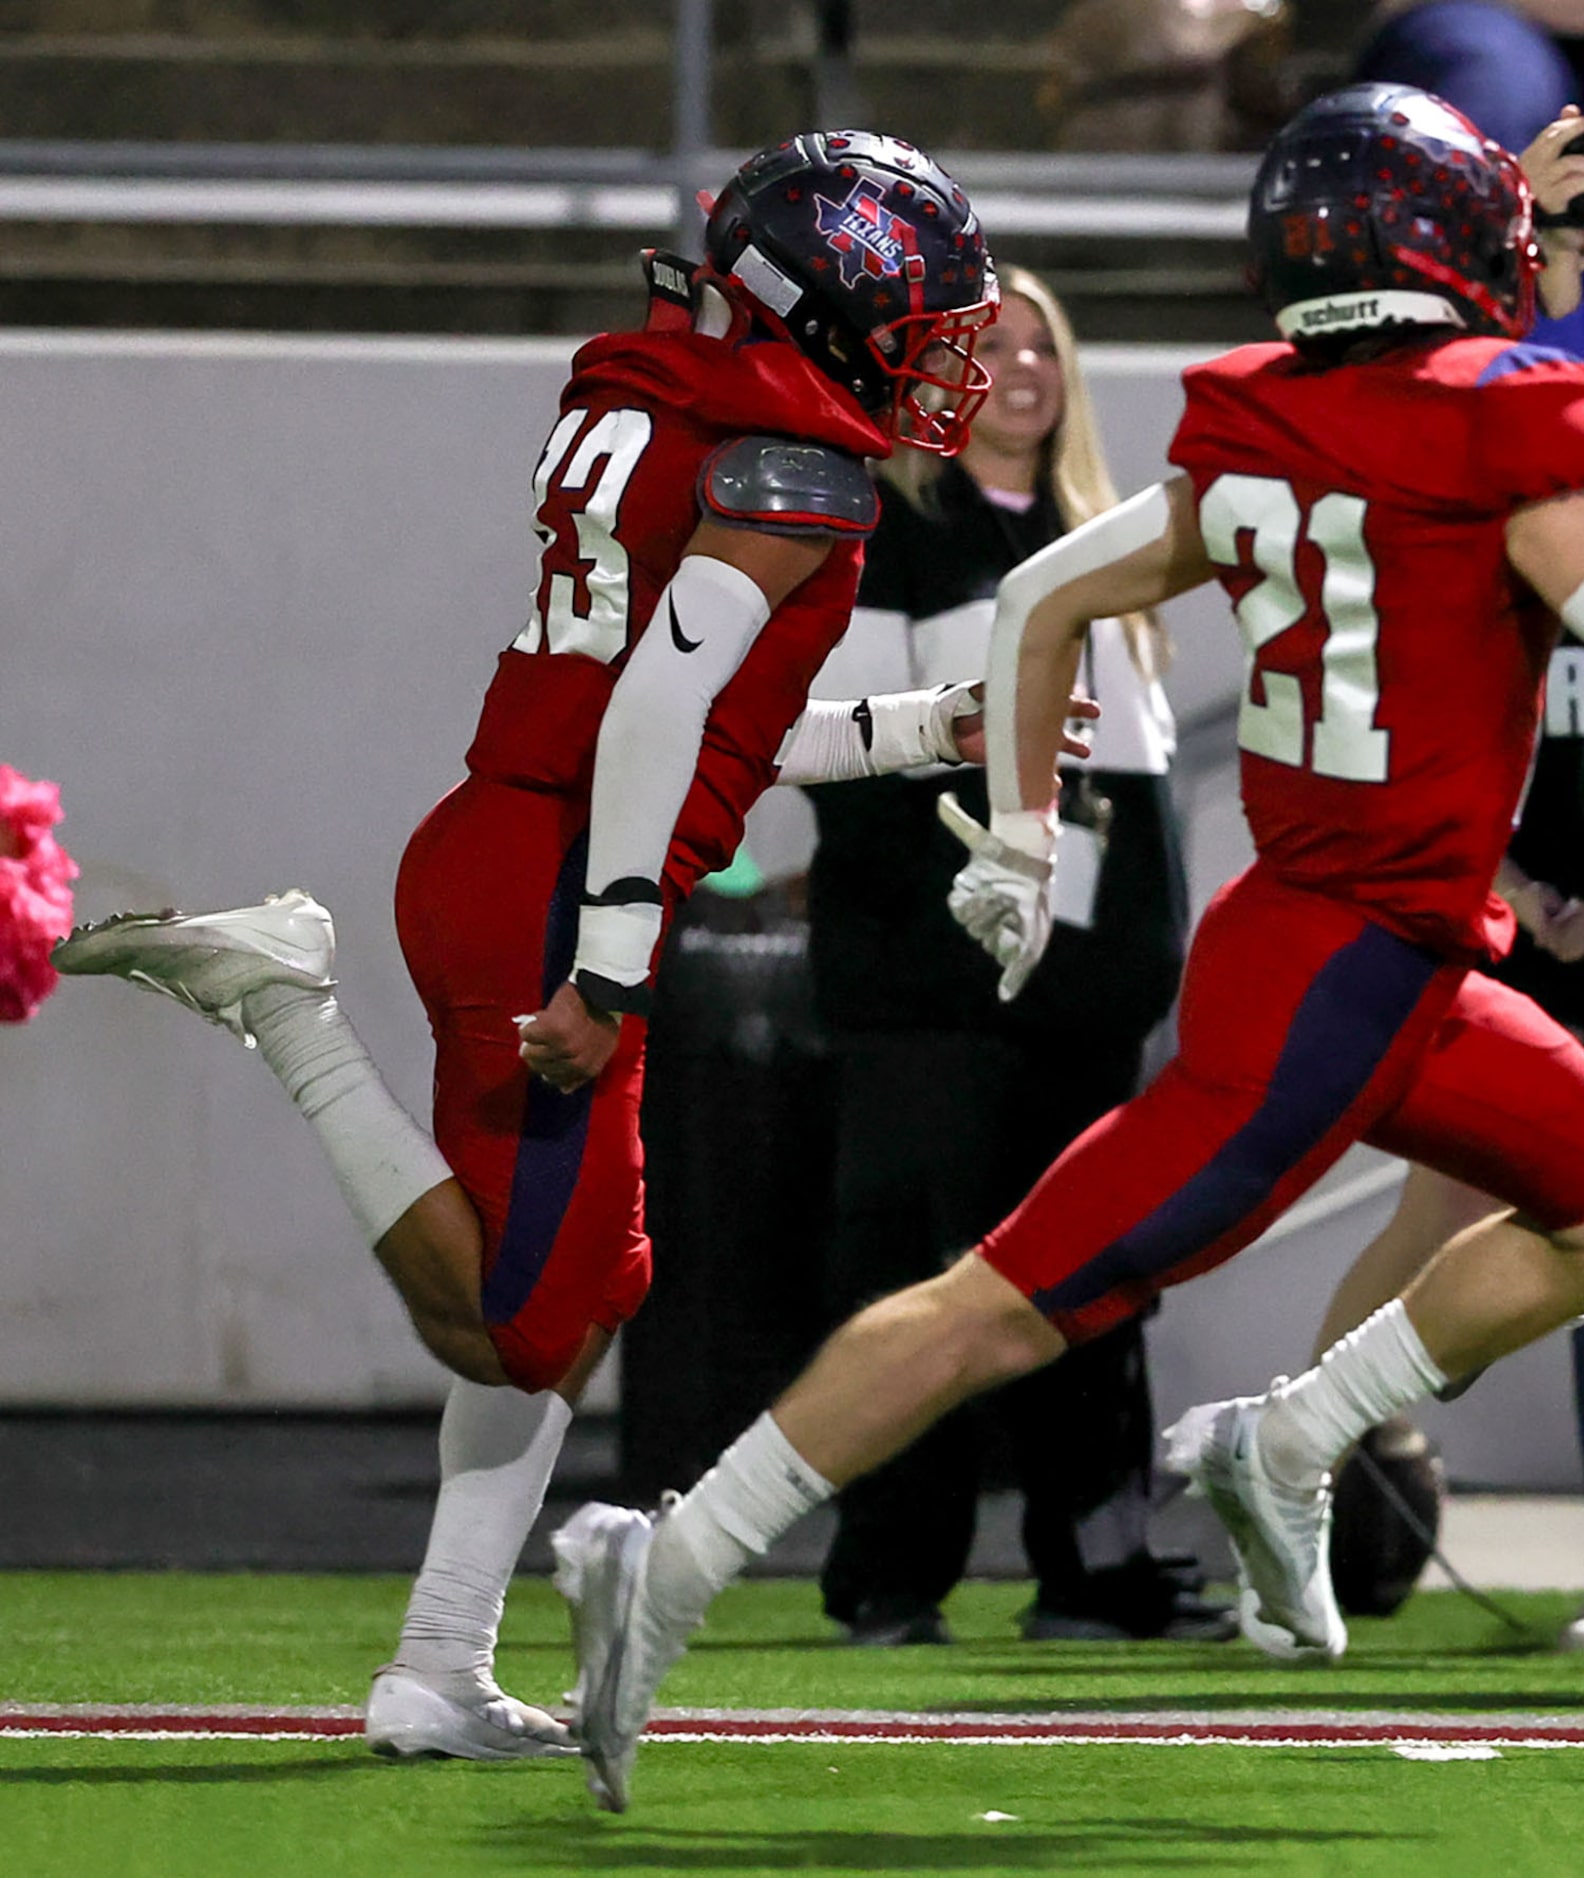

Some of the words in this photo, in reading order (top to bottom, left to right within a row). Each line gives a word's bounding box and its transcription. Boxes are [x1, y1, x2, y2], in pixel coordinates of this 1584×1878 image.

[840, 212, 904, 259] TEXANS
[1302, 299, 1380, 327] schutt
[1198, 471, 1391, 784] 21
